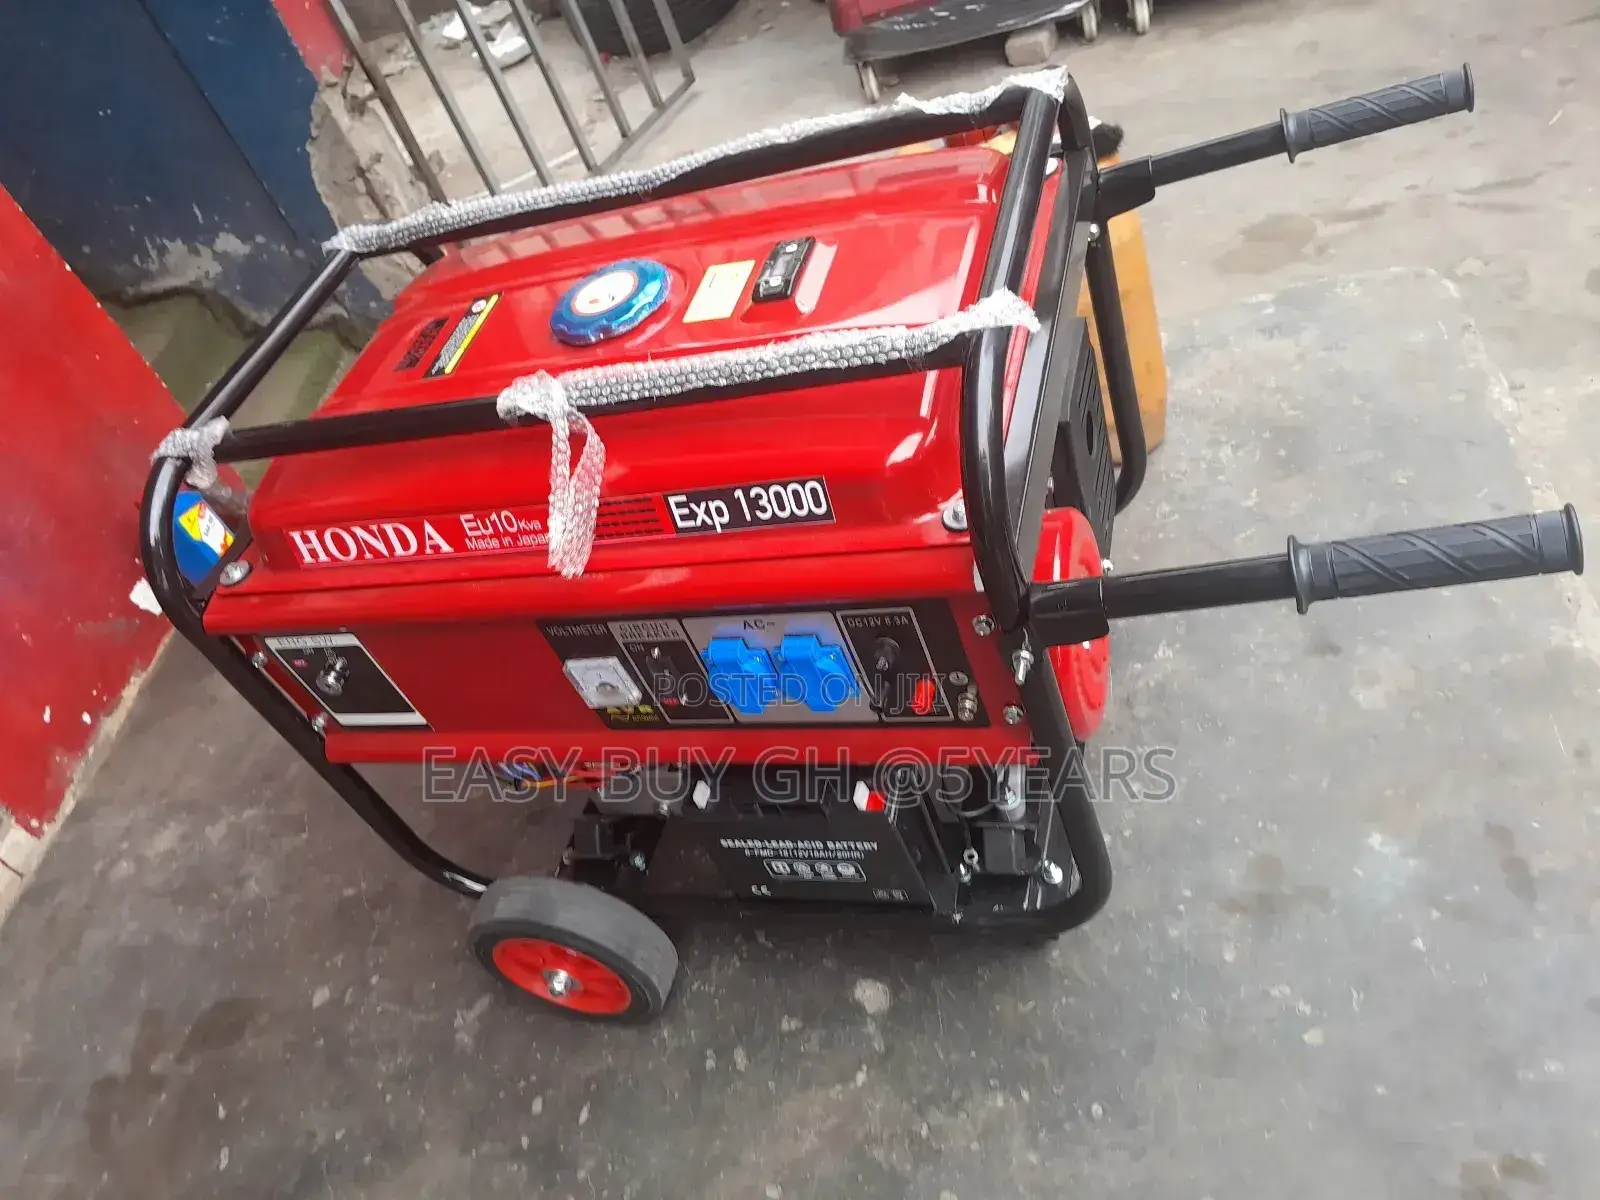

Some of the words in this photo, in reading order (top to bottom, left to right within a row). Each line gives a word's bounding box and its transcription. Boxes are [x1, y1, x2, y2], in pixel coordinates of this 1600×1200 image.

[667, 494, 731, 533] Exp
[733, 480, 828, 522] 13000
[289, 519, 454, 564] HONDA
[464, 535, 500, 550] Made
[501, 535, 515, 549] in
[546, 623, 608, 637] VOLTMETER
